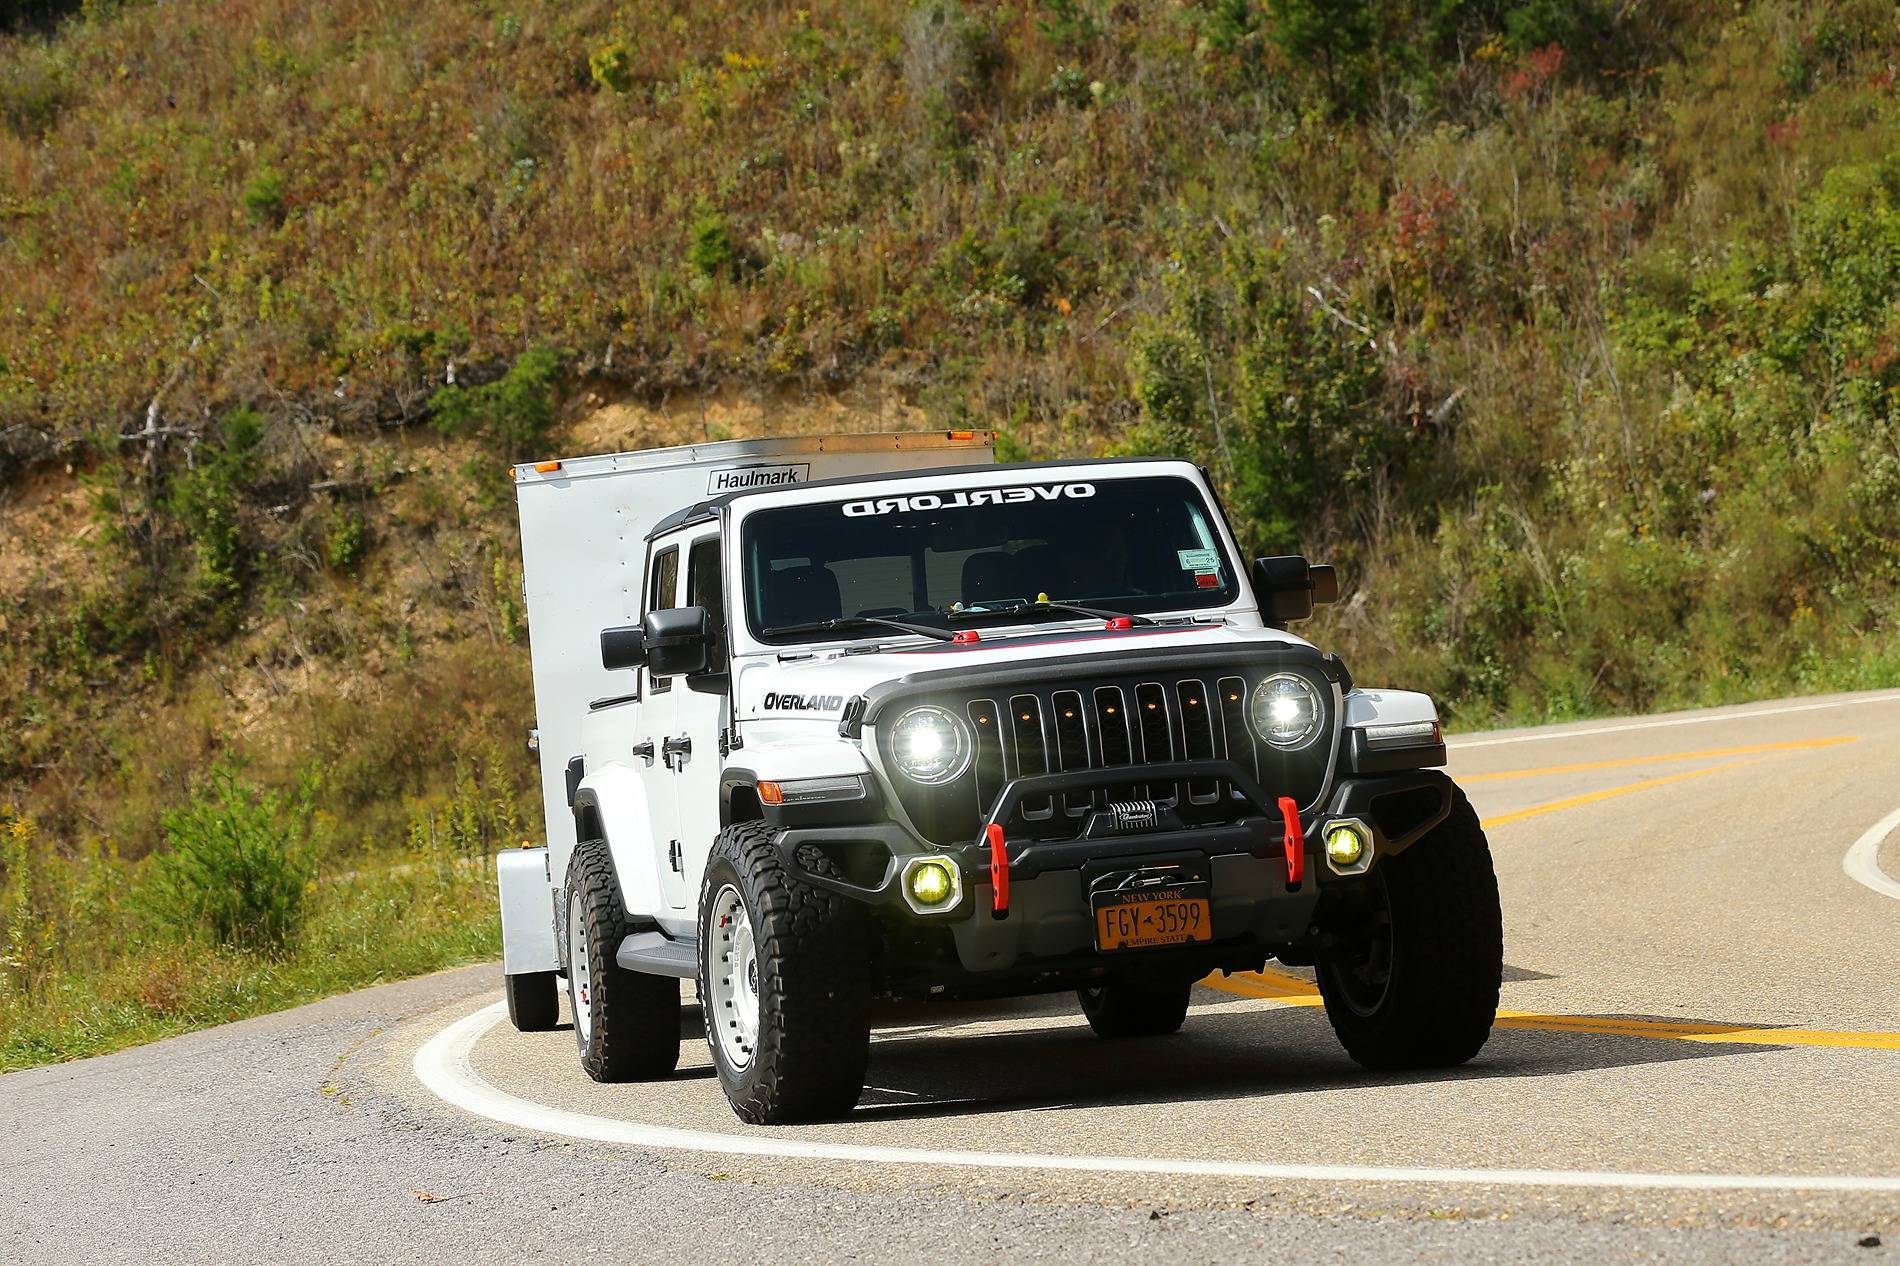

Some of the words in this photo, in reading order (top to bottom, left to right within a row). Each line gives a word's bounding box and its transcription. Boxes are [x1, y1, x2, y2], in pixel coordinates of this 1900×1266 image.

[717, 468, 797, 489] Haulmark
[764, 691, 843, 711] OVERLAND
[1121, 893, 1149, 904] NEW
[1152, 890, 1182, 901] YORK
[1105, 907, 1140, 938] FGY
[1154, 902, 1200, 934] 3599
[1126, 936, 1159, 946] EMPIRE
[1161, 934, 1185, 943] STATE
